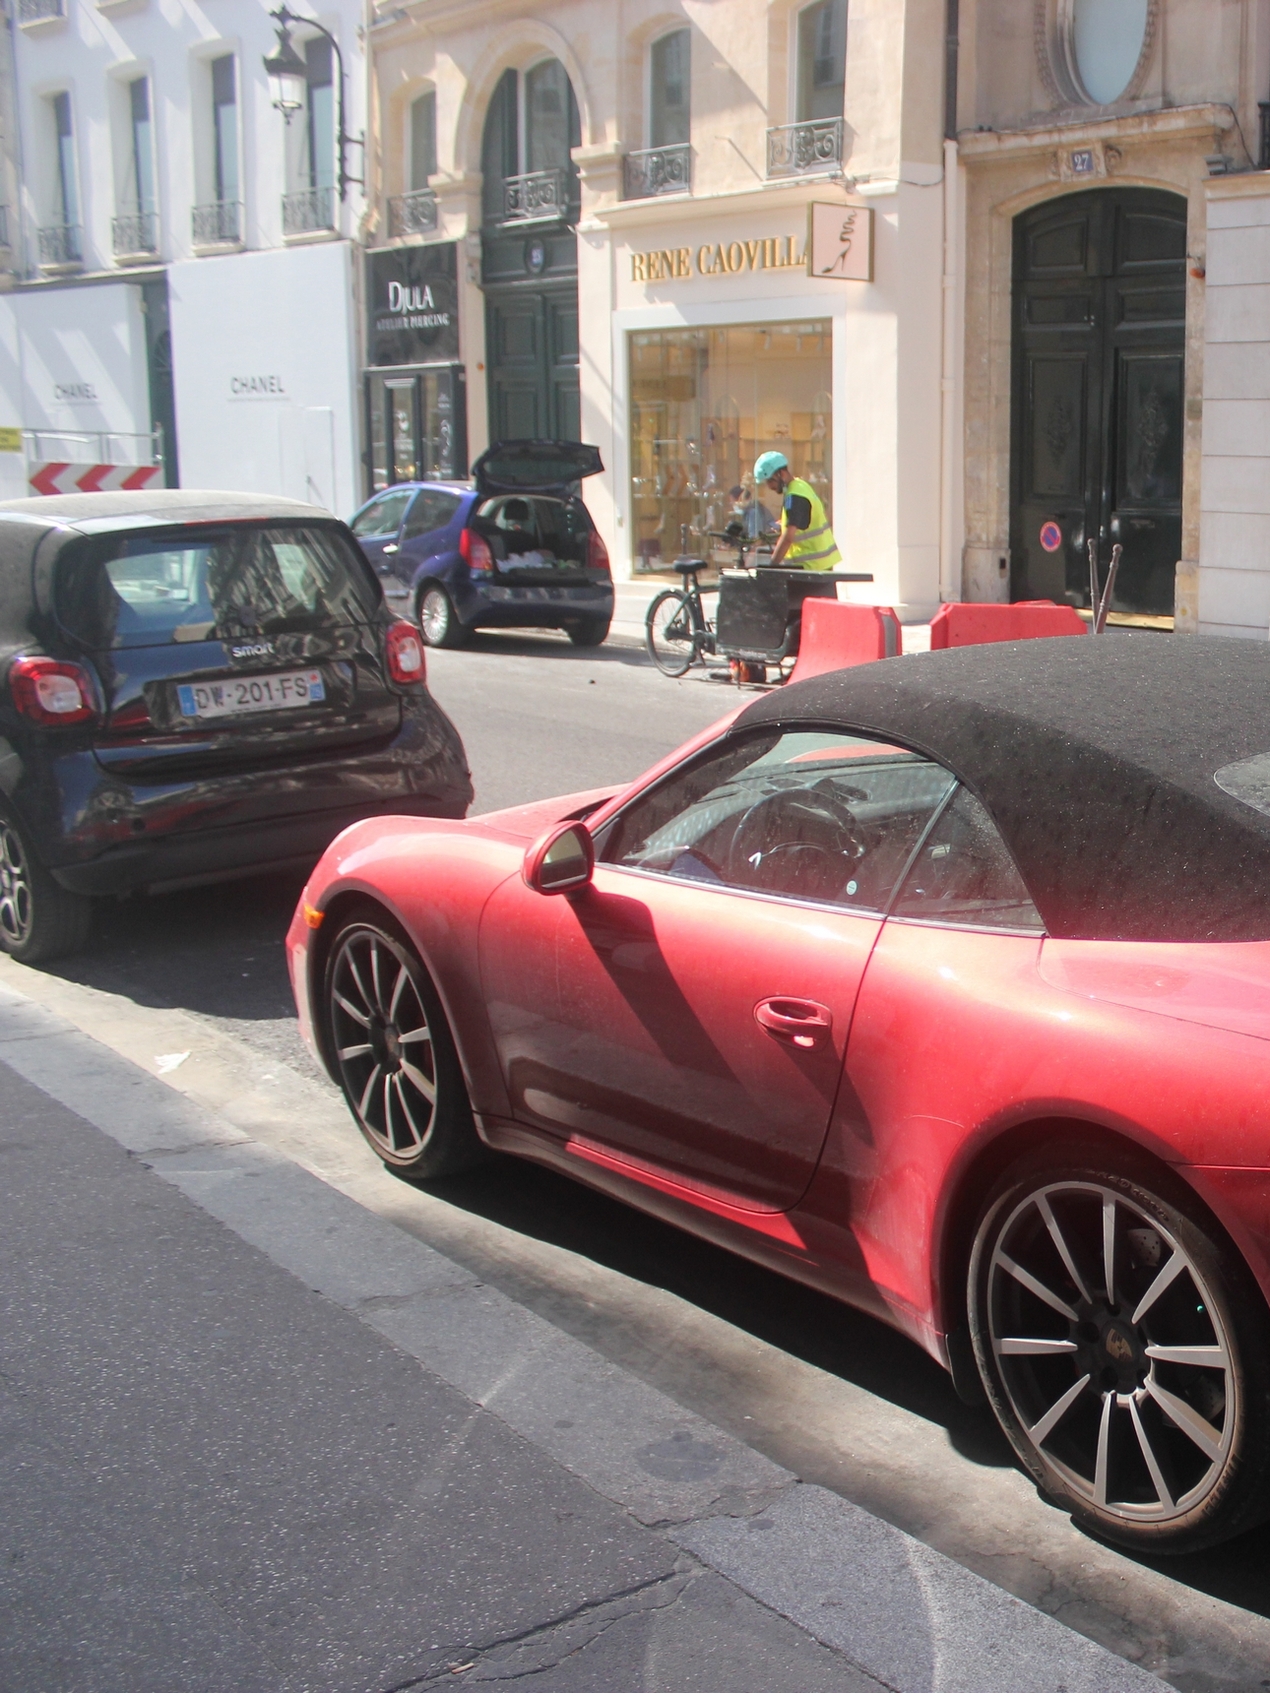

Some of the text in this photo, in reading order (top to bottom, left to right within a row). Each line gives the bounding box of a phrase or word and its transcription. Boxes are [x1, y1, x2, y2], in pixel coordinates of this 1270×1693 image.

[1074, 153, 1089, 170] 27
[631, 235, 808, 282] RENE CAOVILL
[410, 313, 451, 329] PIERCING
[54, 383, 98, 400] CHANEL
[231, 375, 285, 395] CHANEL
[232, 642, 275, 658] smart
